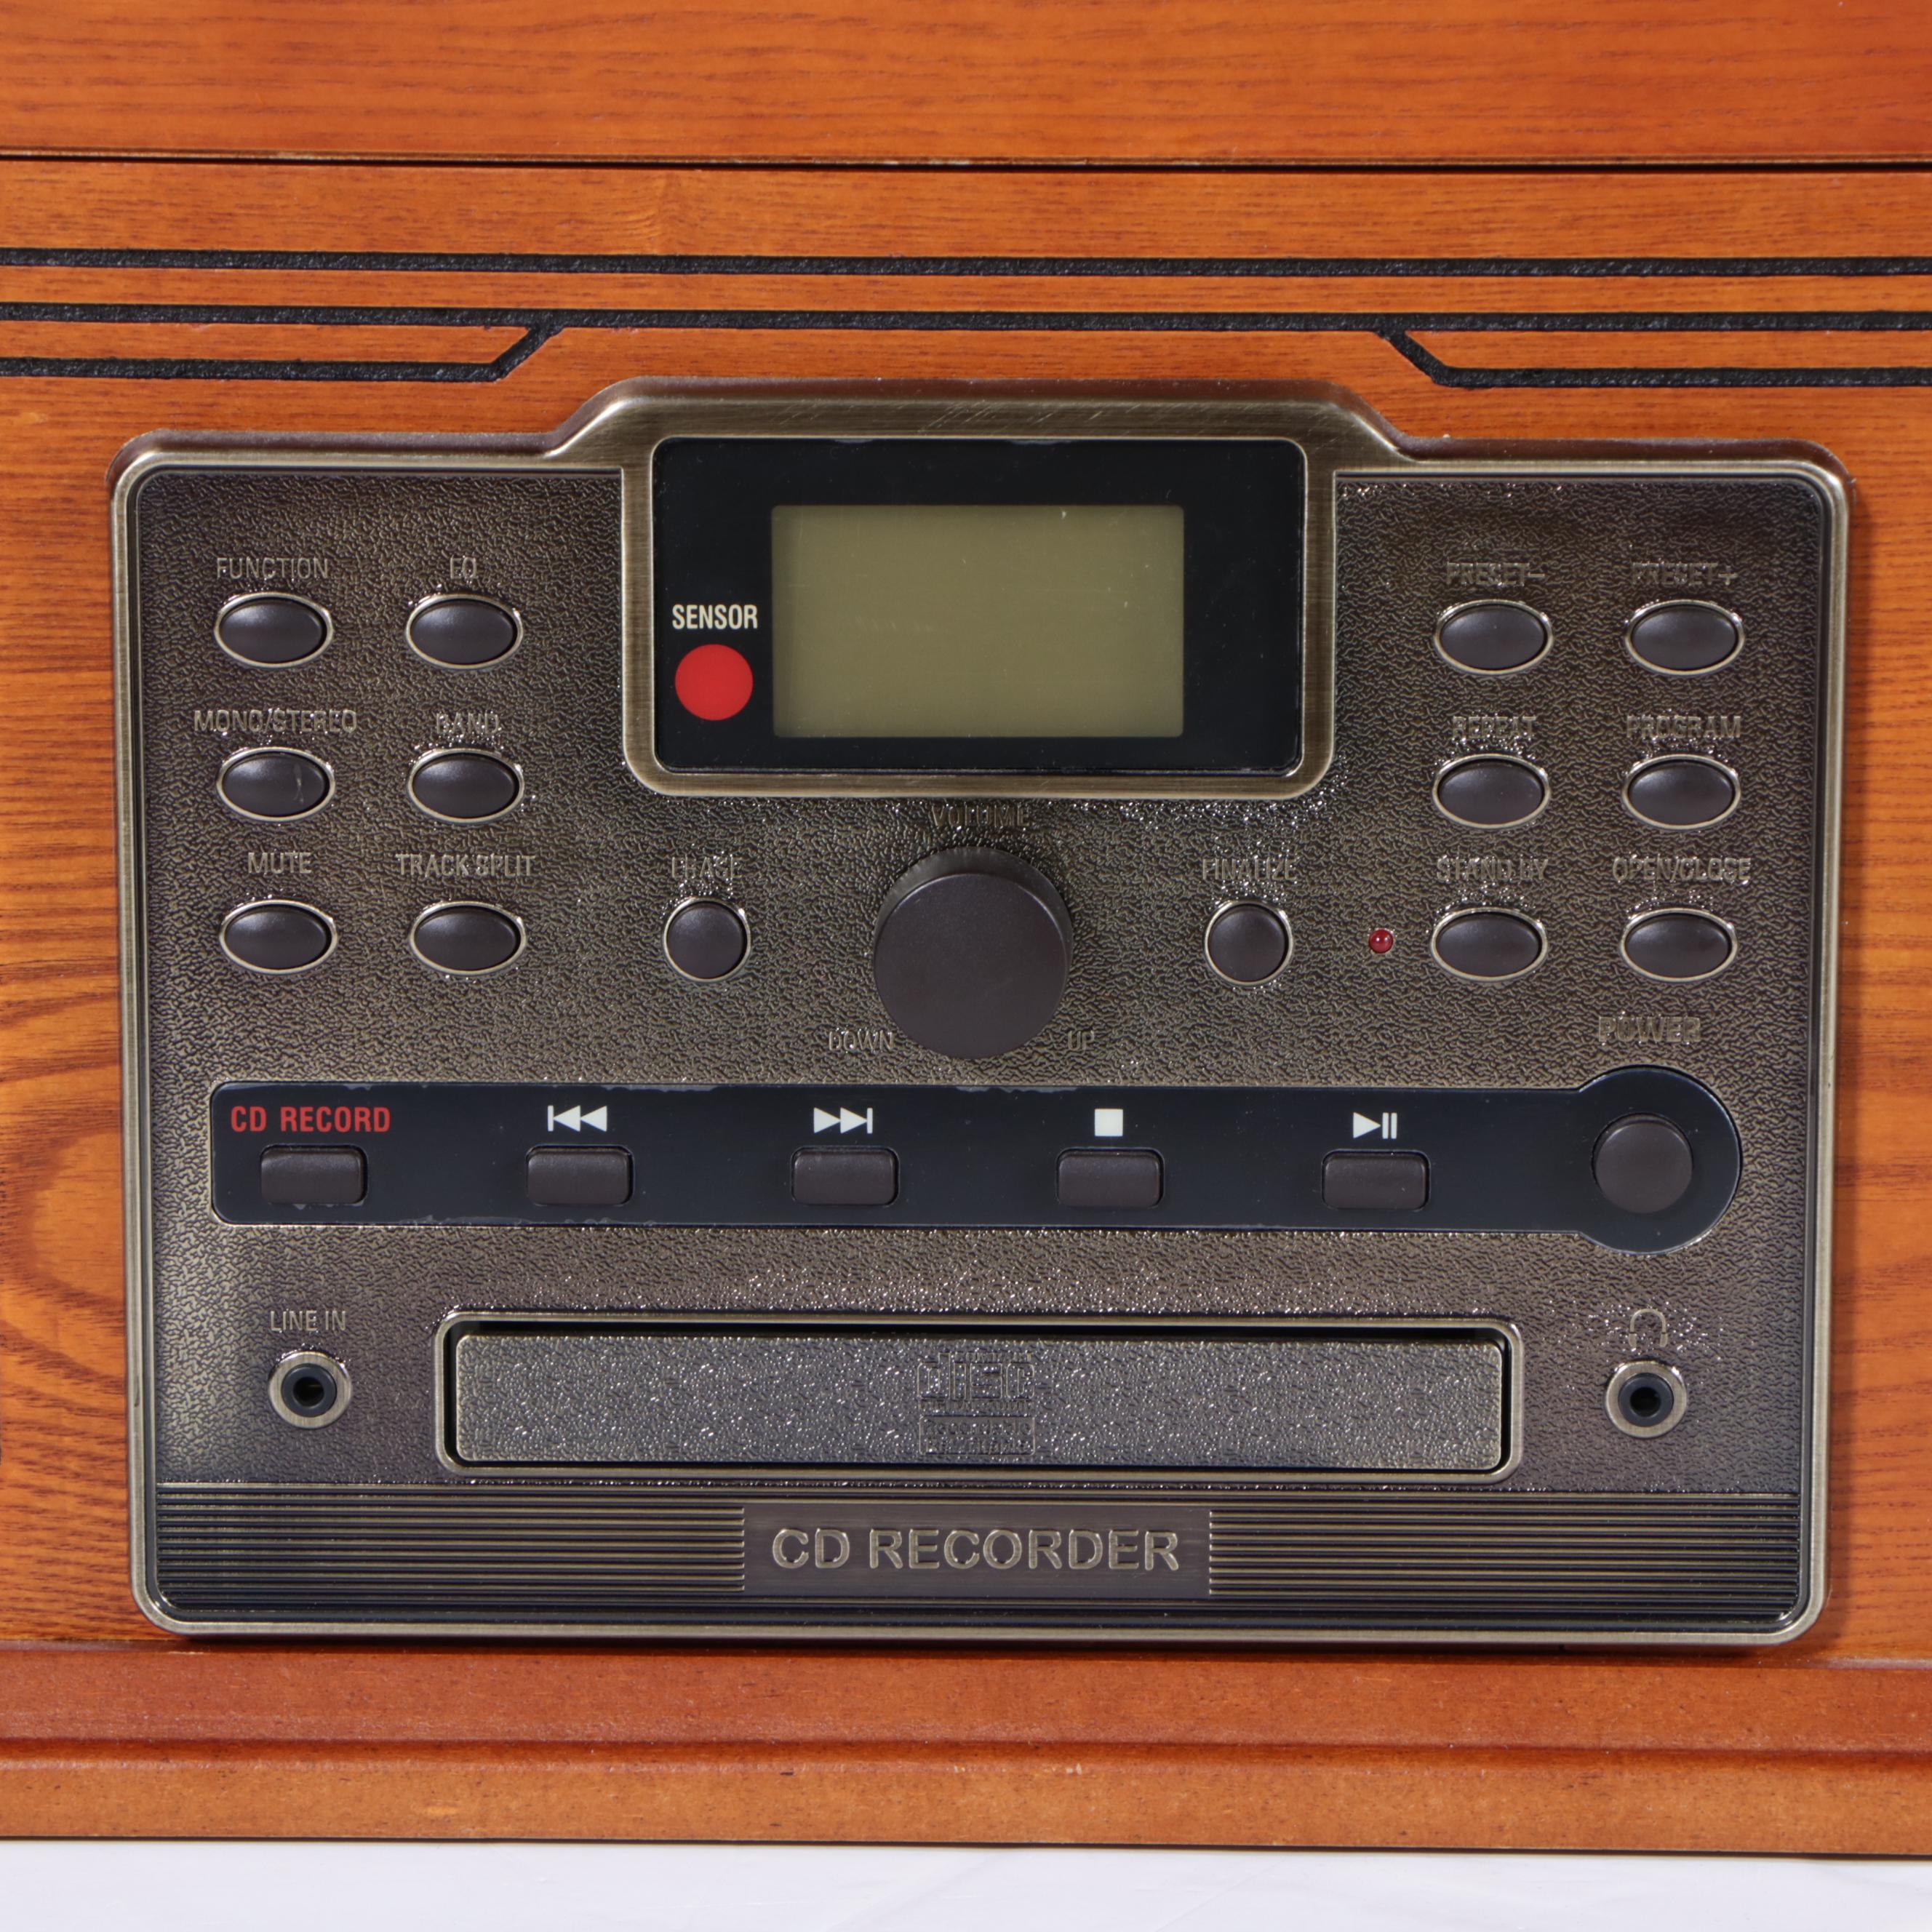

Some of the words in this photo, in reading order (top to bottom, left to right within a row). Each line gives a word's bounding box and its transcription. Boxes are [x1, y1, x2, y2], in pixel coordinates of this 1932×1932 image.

[217, 558, 329, 579] FUNCTION
[672, 604, 758, 629] SENSOR
[193, 710, 357, 733] MONO/STEREO
[436, 712, 500, 733] BAND
[1454, 716, 1536, 738] REPEAT
[1626, 716, 1741, 738] PROGRAM
[931, 805, 1030, 827] VOLUME
[247, 853, 312, 874] MUTE
[395, 854, 469, 877] TRACK
[476, 854, 536, 876] SPLIT
[1202, 858, 1297, 880] FINALIZE
[1612, 858, 1751, 882] OPEN/CLOSE
[1598, 1016, 1701, 1042] POWER
[829, 1031, 895, 1051] DOWN
[1068, 1030, 1095, 1051] UP
[231, 1106, 267, 1133] CD
[280, 1106, 391, 1133] RECORD
[270, 1310, 318, 1331] LINE
[325, 1310, 346, 1331] IN
[773, 1528, 851, 1569] CD
[869, 1529, 1180, 1571] RECORDER
